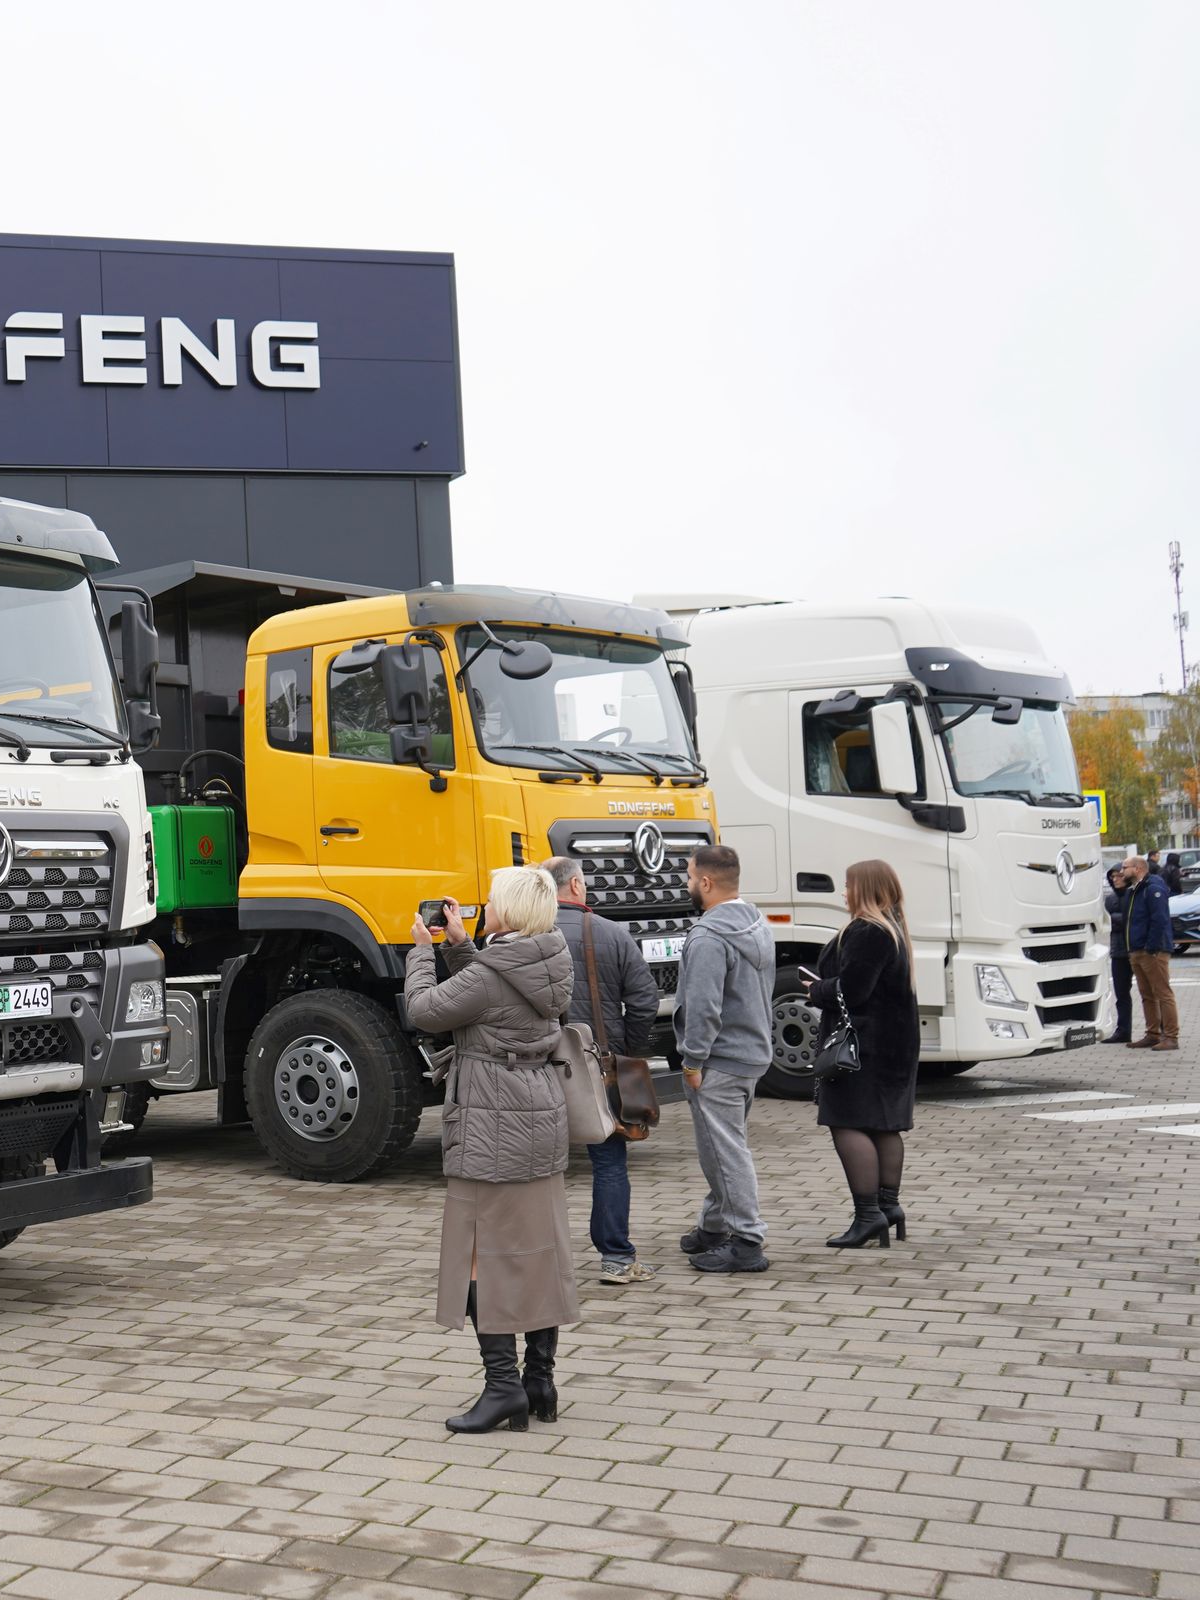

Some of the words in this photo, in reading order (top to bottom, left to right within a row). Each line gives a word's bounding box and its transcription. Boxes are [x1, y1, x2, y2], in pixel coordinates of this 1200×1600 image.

[607, 800, 676, 817] DONGFENG
[1041, 818, 1081, 829] DONGFENG
[13, 987, 49, 1010] 2449
